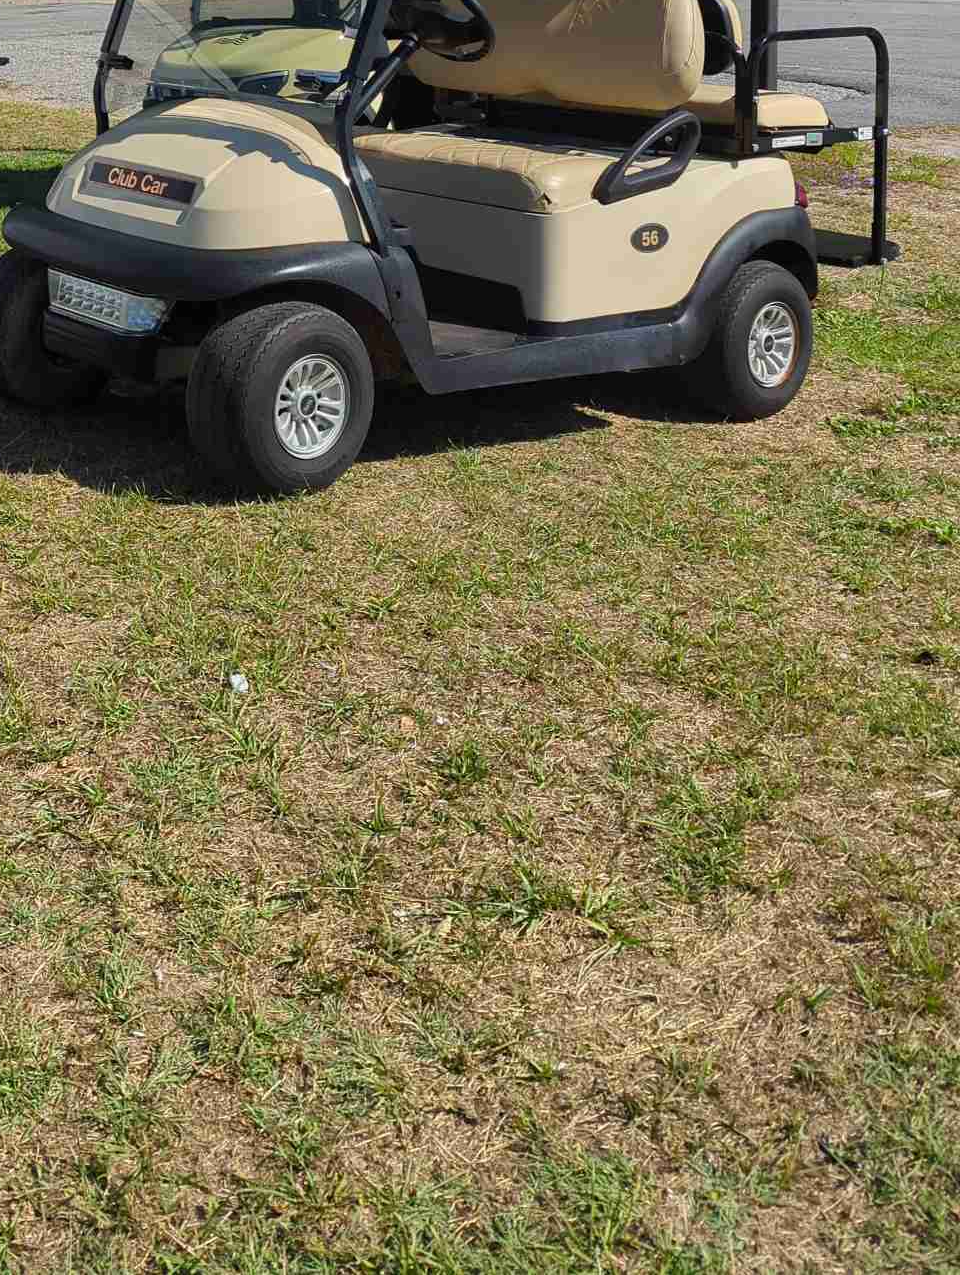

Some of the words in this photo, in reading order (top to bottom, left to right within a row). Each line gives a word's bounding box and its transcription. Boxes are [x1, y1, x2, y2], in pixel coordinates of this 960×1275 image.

[108, 167, 138, 188] Club
[140, 174, 168, 195] Car
[641, 230, 659, 246] 56
